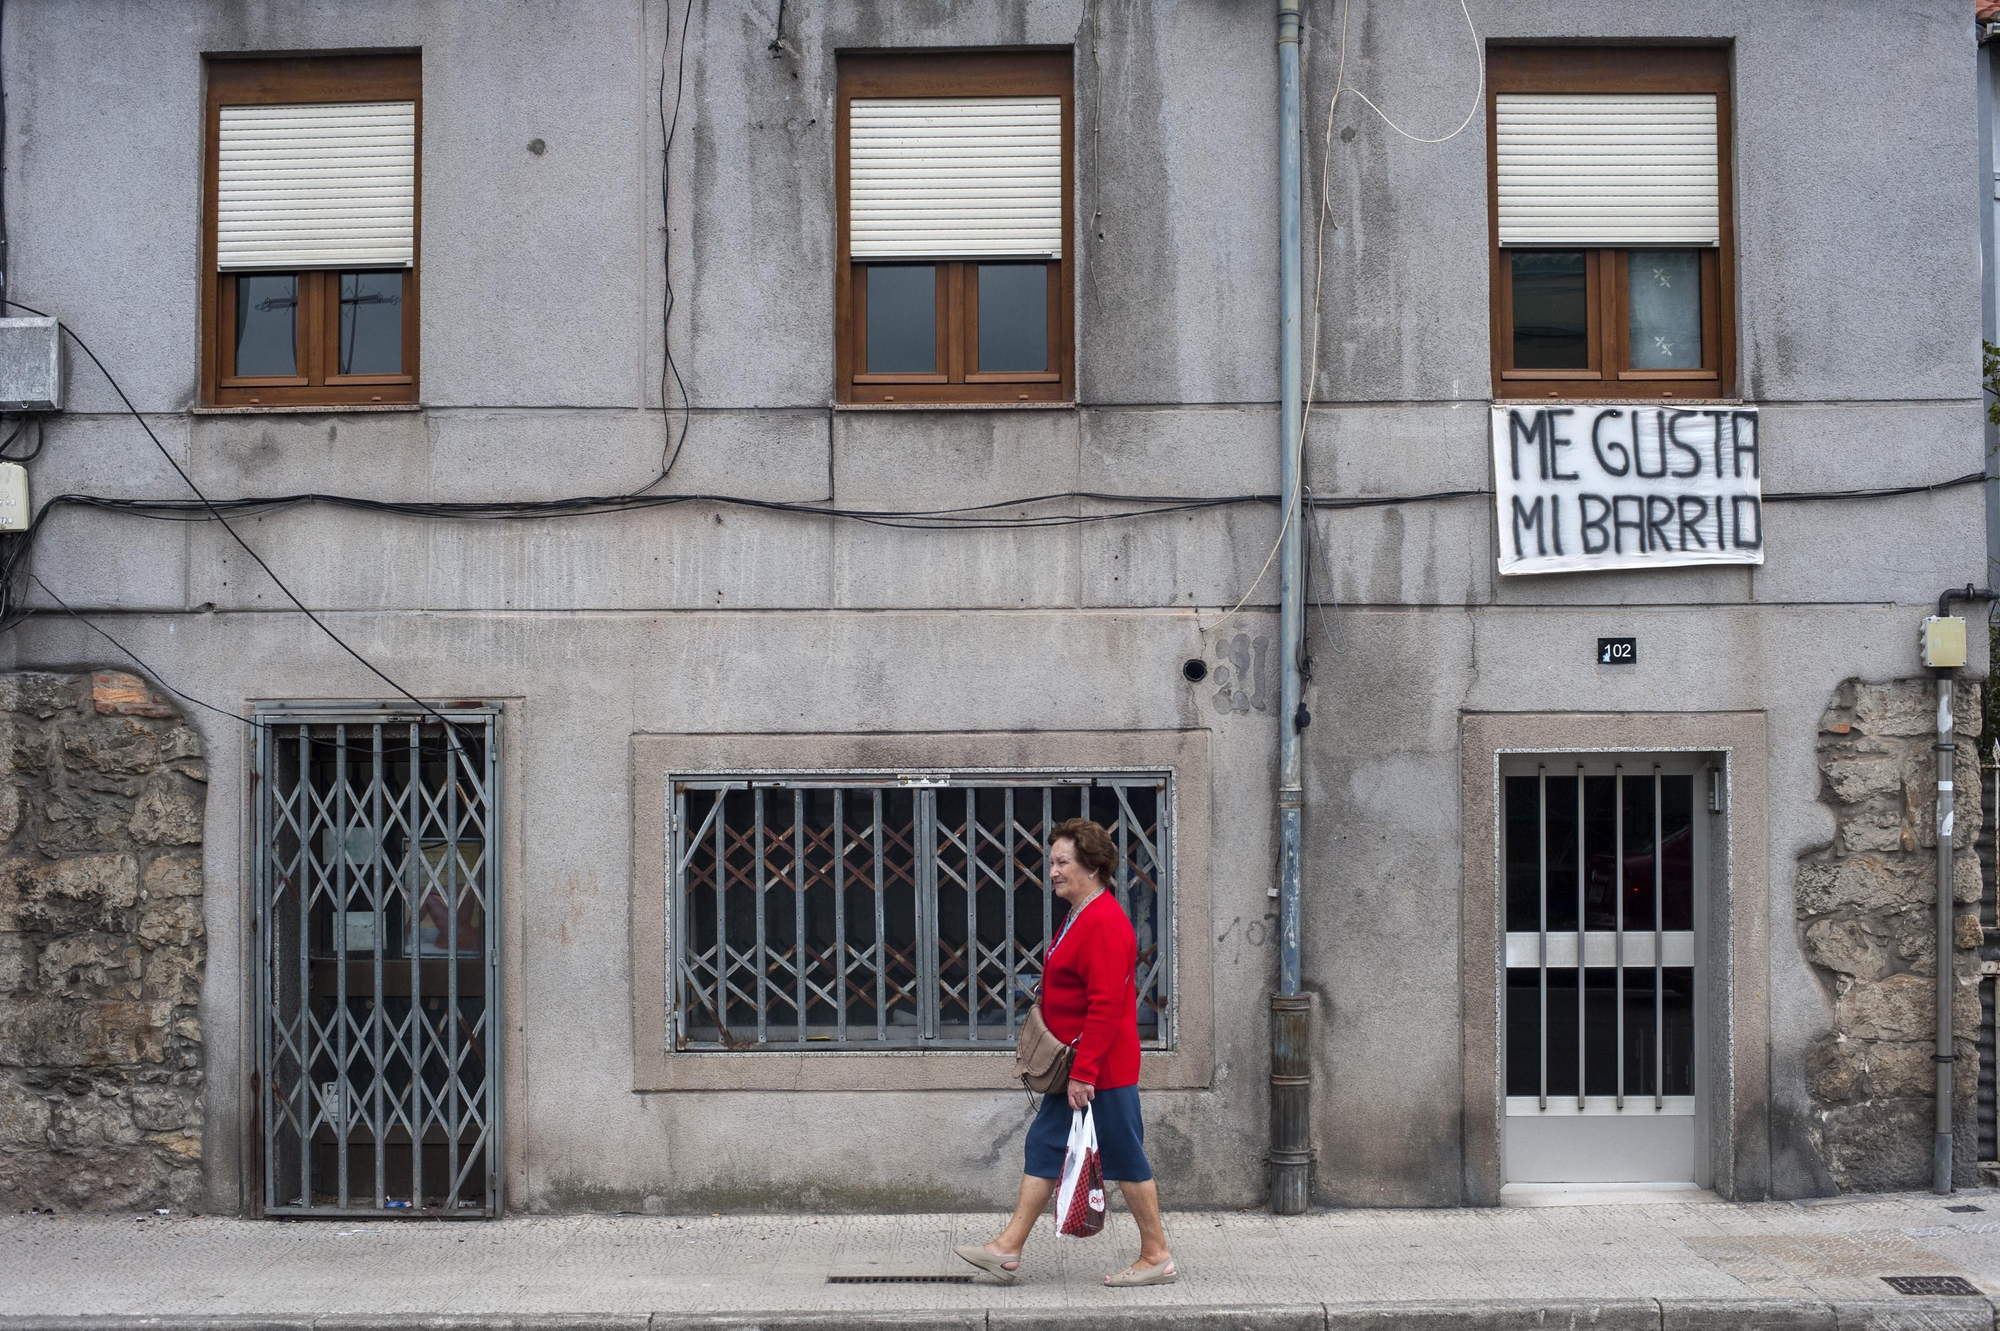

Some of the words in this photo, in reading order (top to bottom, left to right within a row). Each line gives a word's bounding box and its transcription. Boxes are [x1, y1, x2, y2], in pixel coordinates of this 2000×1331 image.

[1509, 408, 1579, 481] ME
[1592, 408, 1760, 479] GUSTA
[1511, 493, 1564, 556] MI
[1578, 493, 1763, 554] BARRIO
[1604, 643, 1632, 658] 102
